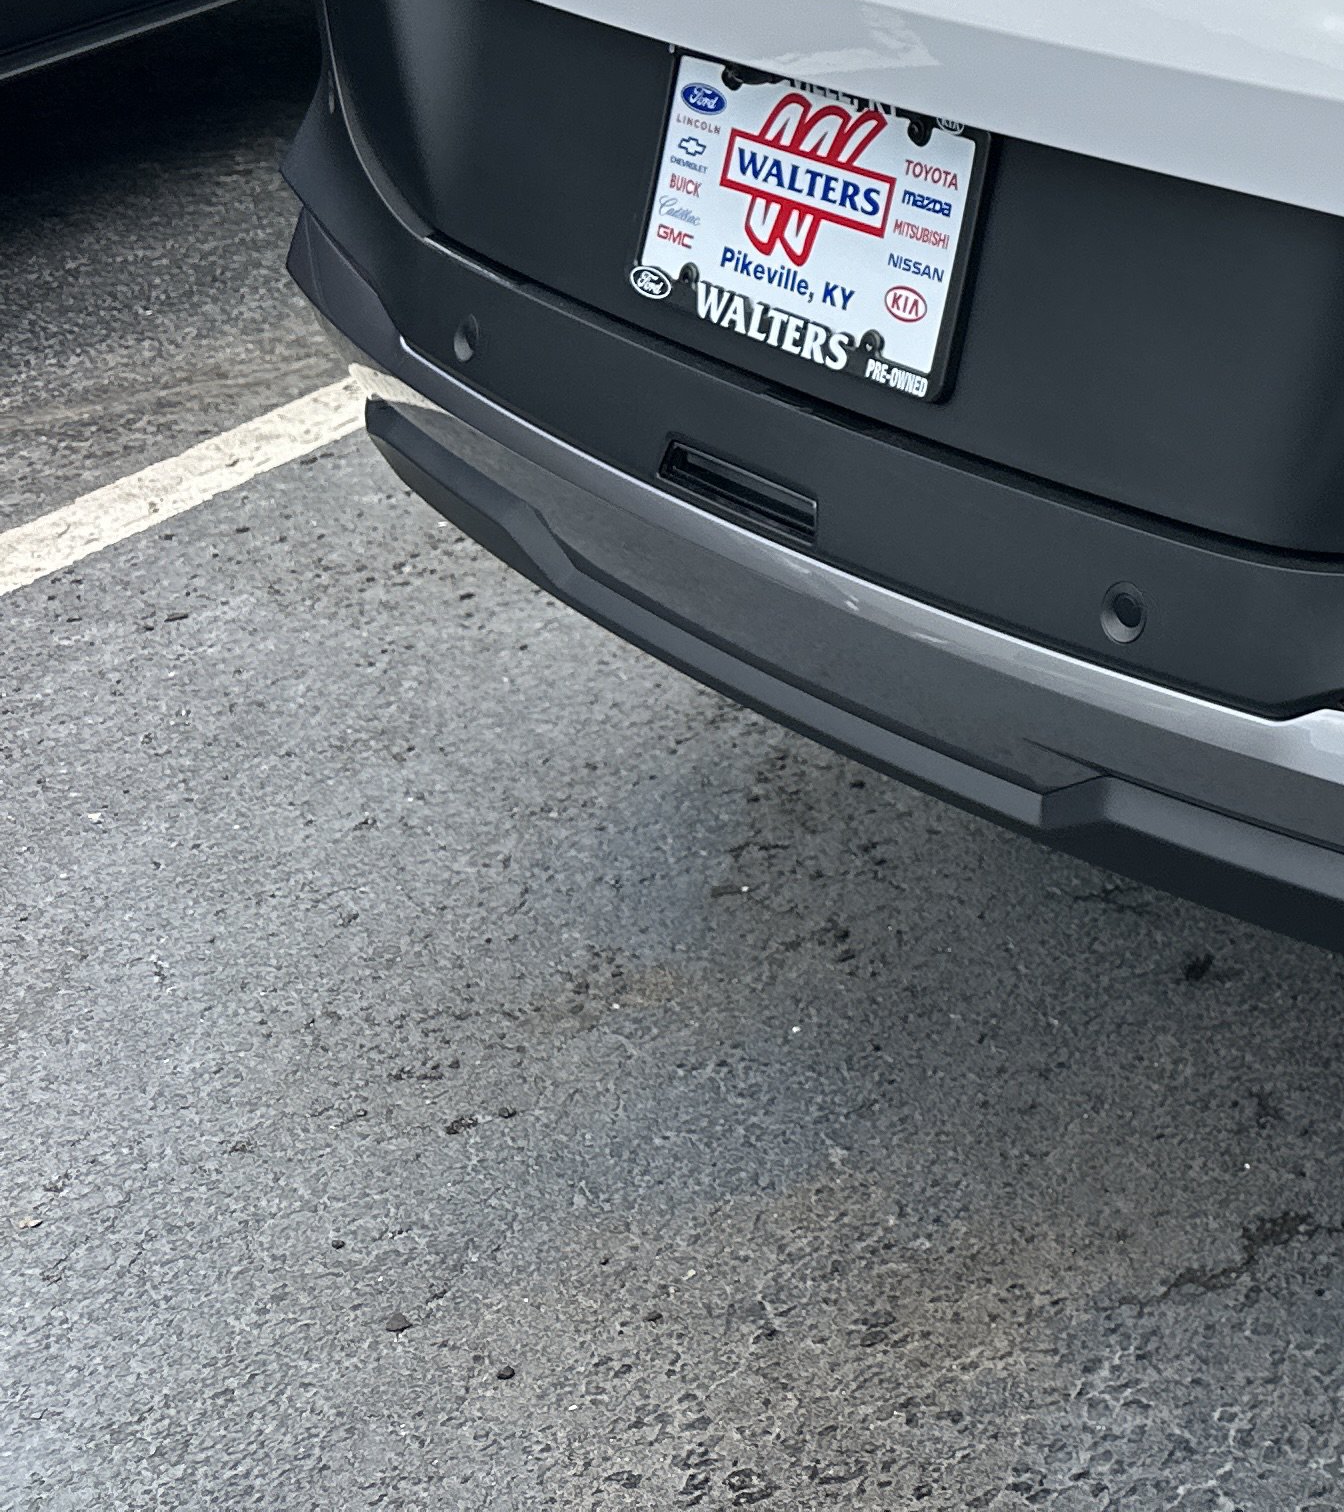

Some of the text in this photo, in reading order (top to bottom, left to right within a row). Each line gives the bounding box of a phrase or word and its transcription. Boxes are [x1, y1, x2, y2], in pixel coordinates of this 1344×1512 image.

[688, 86, 719, 110] Ford
[675, 113, 721, 135] LINCOLN
[669, 154, 708, 174] CHEVROLET
[904, 159, 959, 190] TOYOTA
[669, 173, 702, 198] BUICK
[737, 146, 882, 217] WALTERS
[658, 194, 701, 226] Cadillac
[657, 223, 694, 249] GMC
[893, 218, 951, 249] MITSUBISHI
[720, 245, 856, 312] Pikeville, KY
[887, 252, 945, 283] NISSAN
[890, 292, 920, 318] KIA
[698, 282, 849, 371] WALTERS
[865, 358, 929, 398] PRE-OWNED
